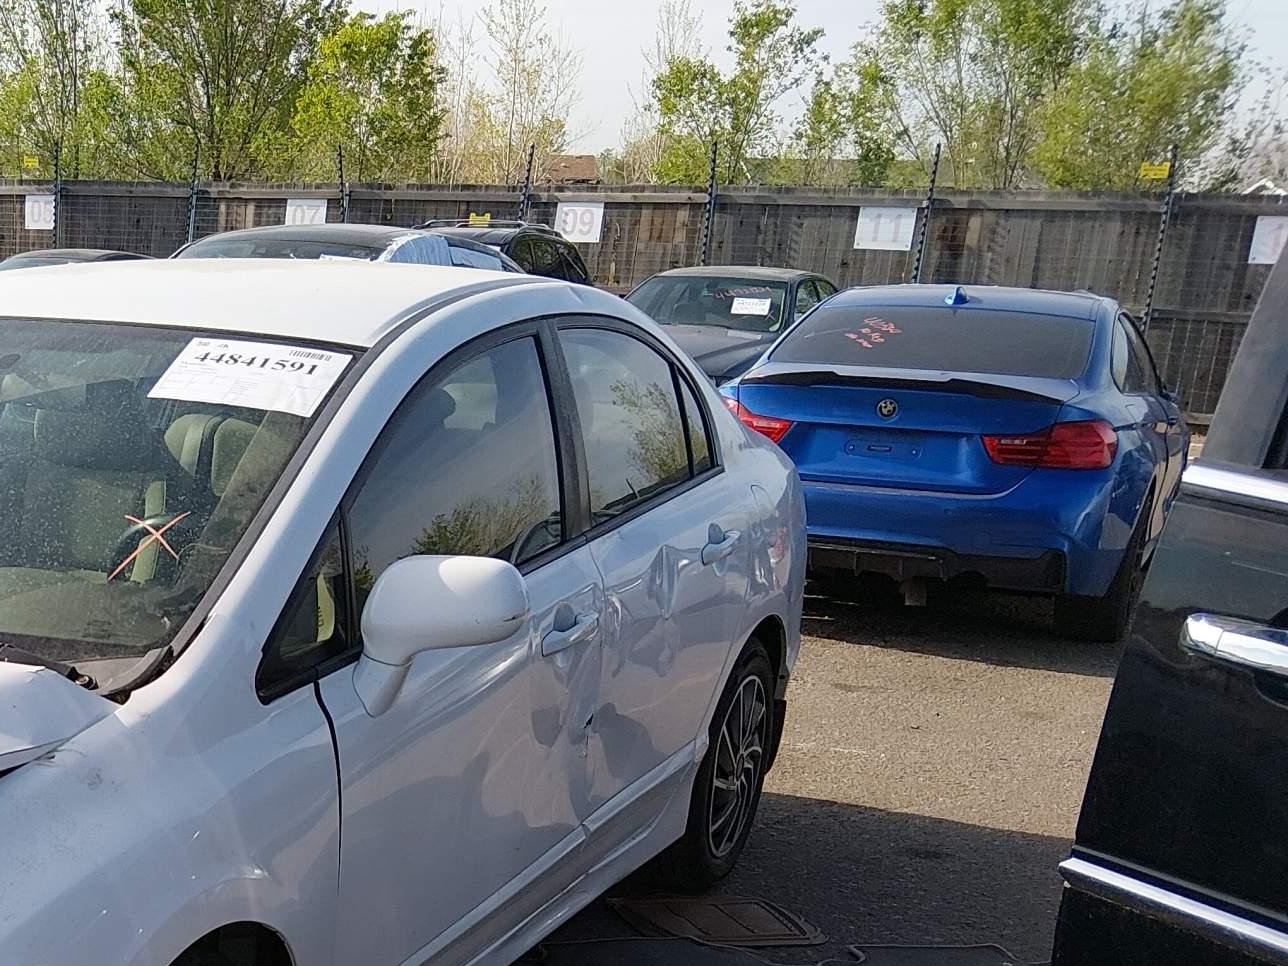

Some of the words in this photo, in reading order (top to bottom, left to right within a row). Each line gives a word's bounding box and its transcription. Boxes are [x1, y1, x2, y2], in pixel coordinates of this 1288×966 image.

[562, 208, 595, 236] 09
[870, 213, 903, 243] 11
[194, 351, 319, 376] 44841591
